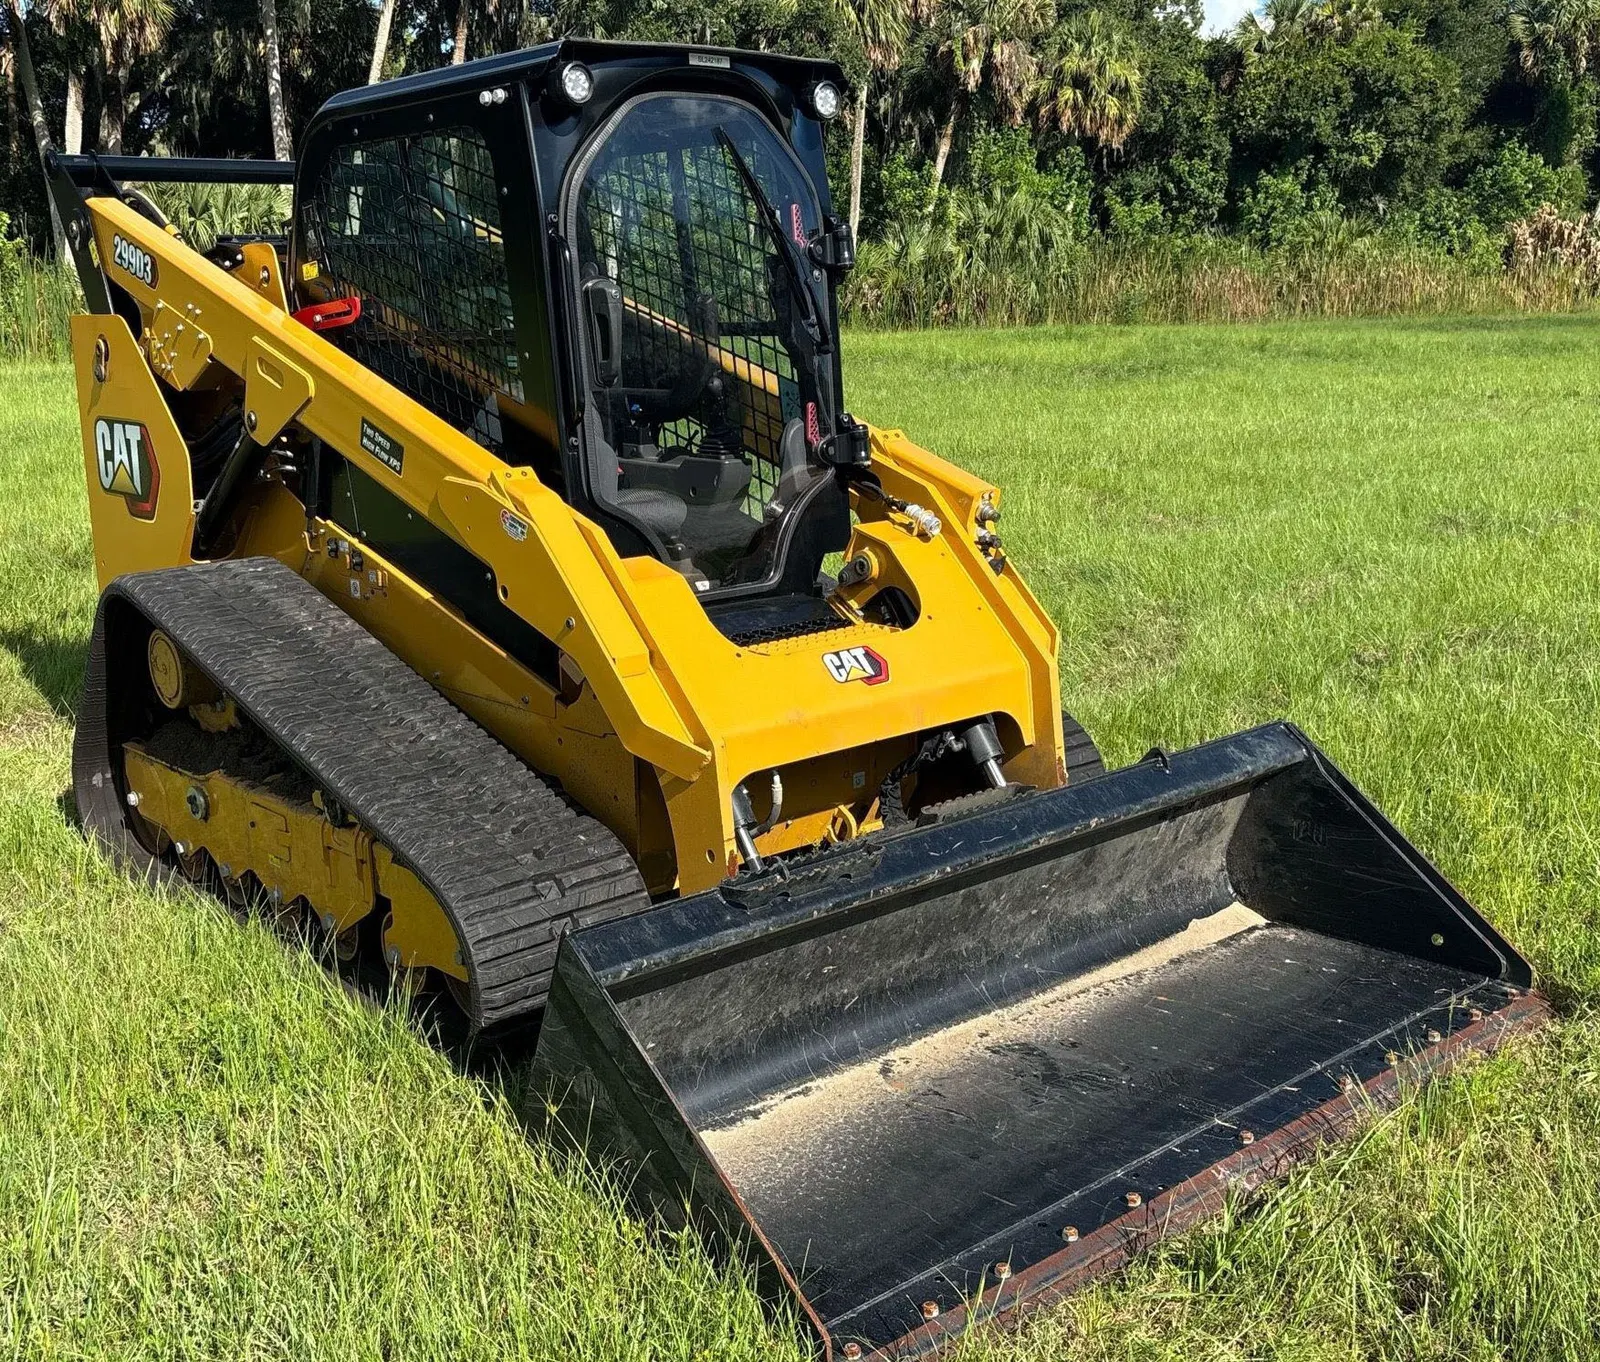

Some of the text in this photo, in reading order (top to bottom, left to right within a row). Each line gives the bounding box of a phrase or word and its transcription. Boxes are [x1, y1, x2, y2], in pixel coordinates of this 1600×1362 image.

[113, 234, 152, 285] 299D3
[96, 420, 142, 496] CAT
[388, 455, 401, 471] XPS
[822, 646, 876, 683] CAT
